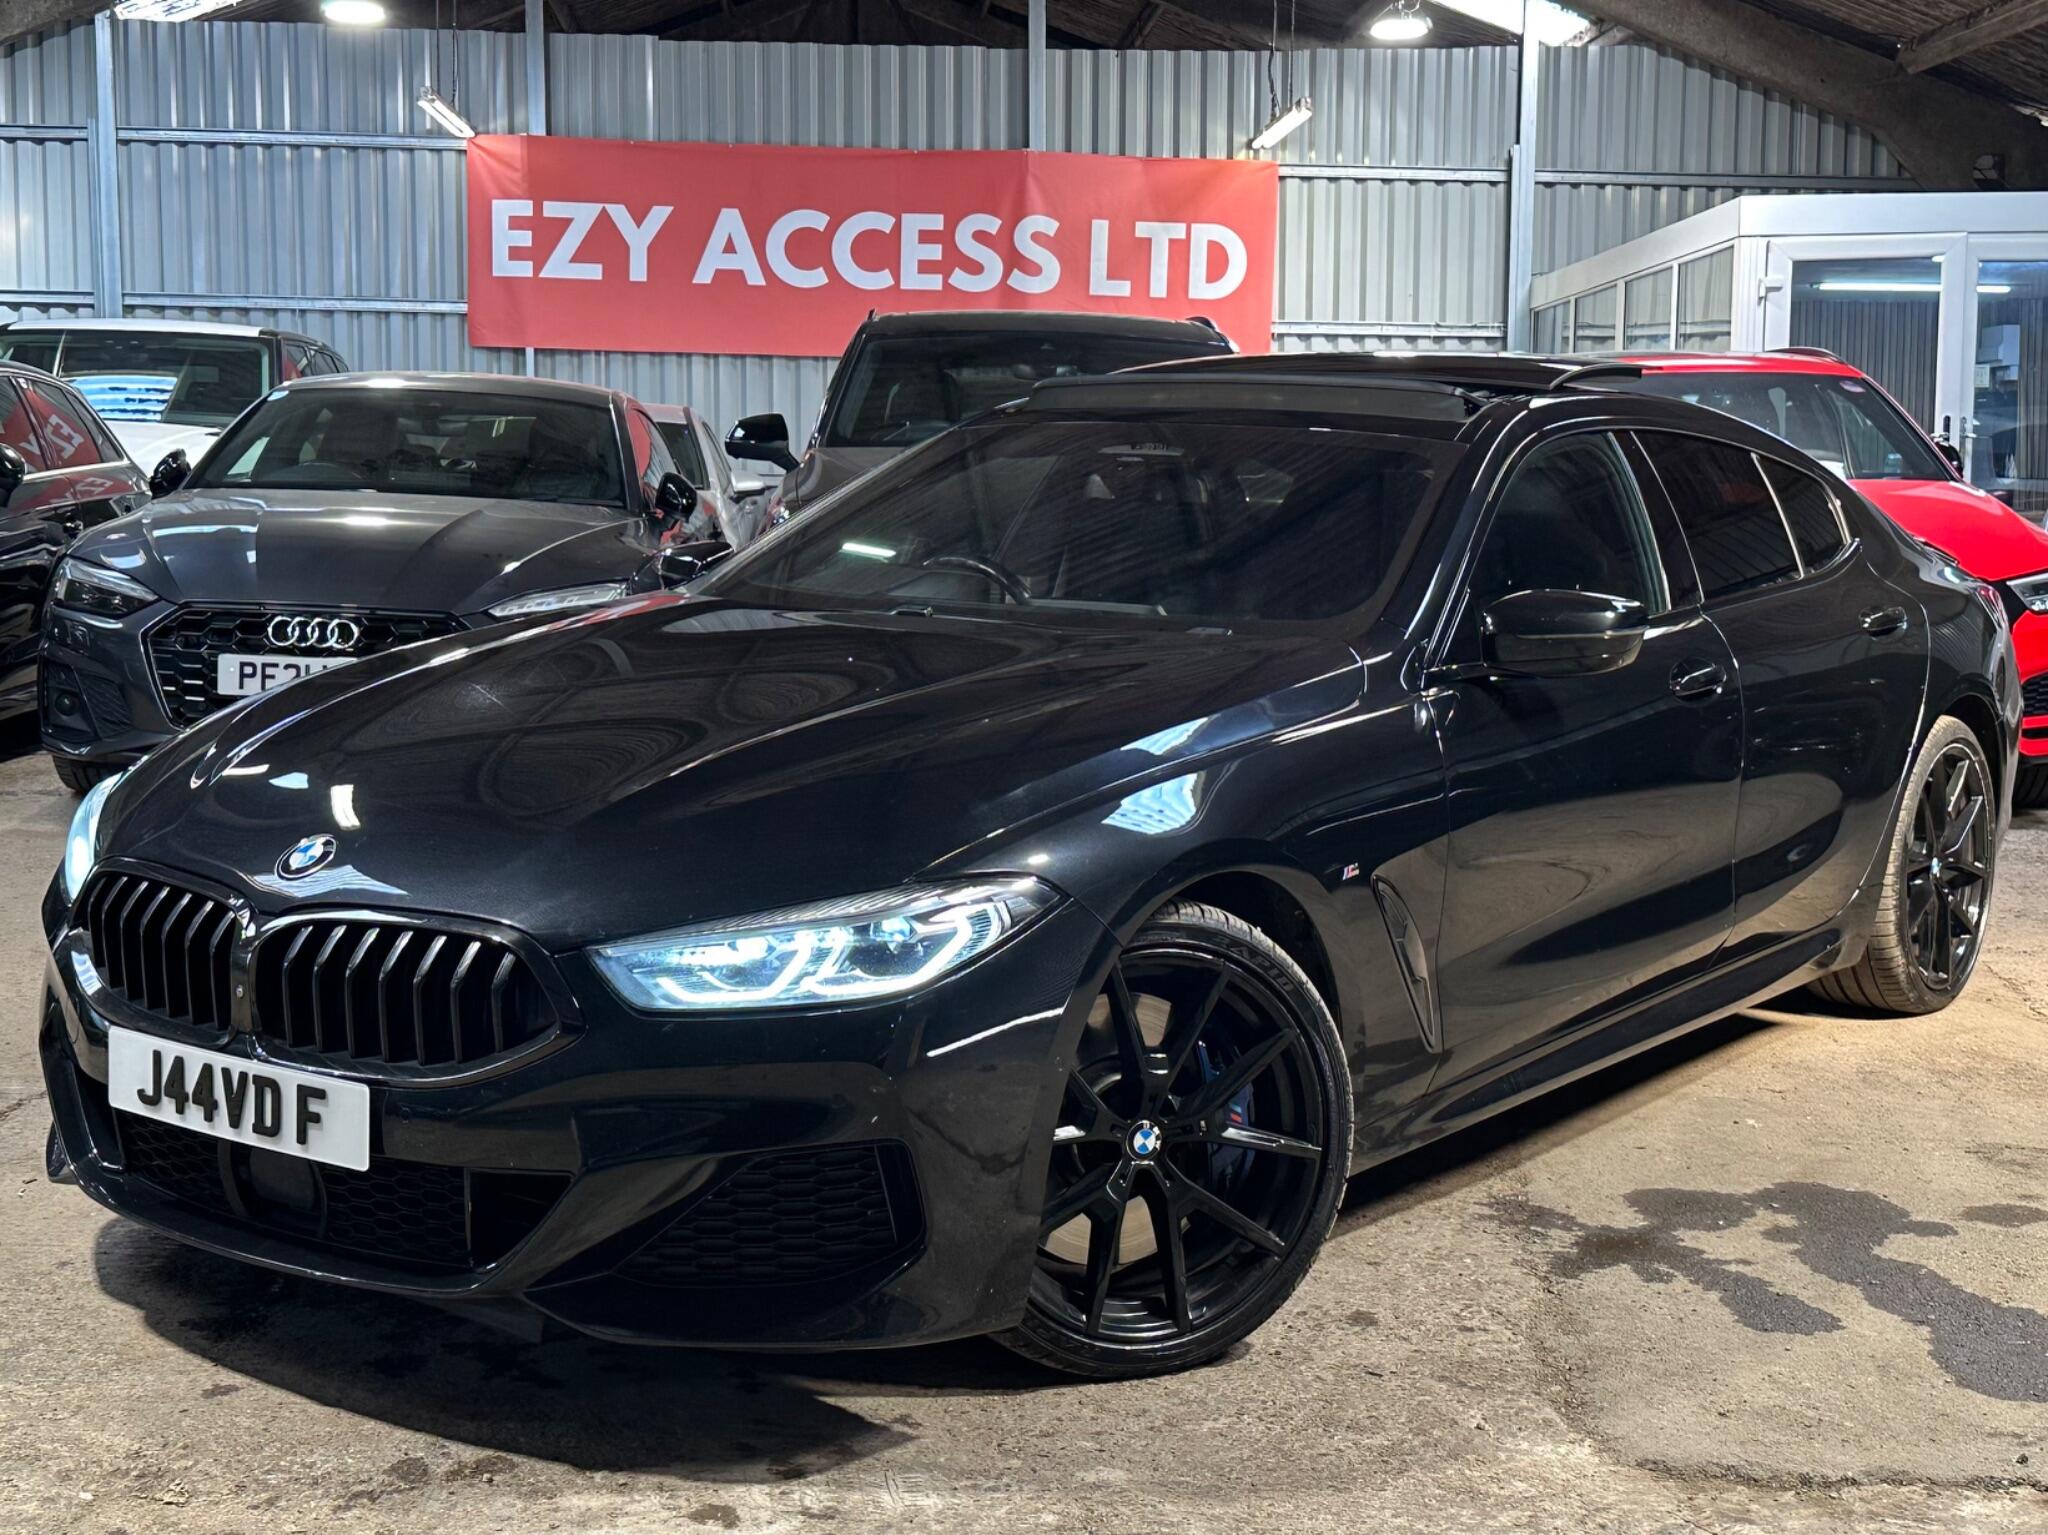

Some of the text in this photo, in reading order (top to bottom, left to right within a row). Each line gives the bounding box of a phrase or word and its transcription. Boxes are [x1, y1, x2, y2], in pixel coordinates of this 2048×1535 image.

[491, 199, 1248, 300] EZY ACCESS LTD
[137, 1050, 326, 1145] J44VD F
